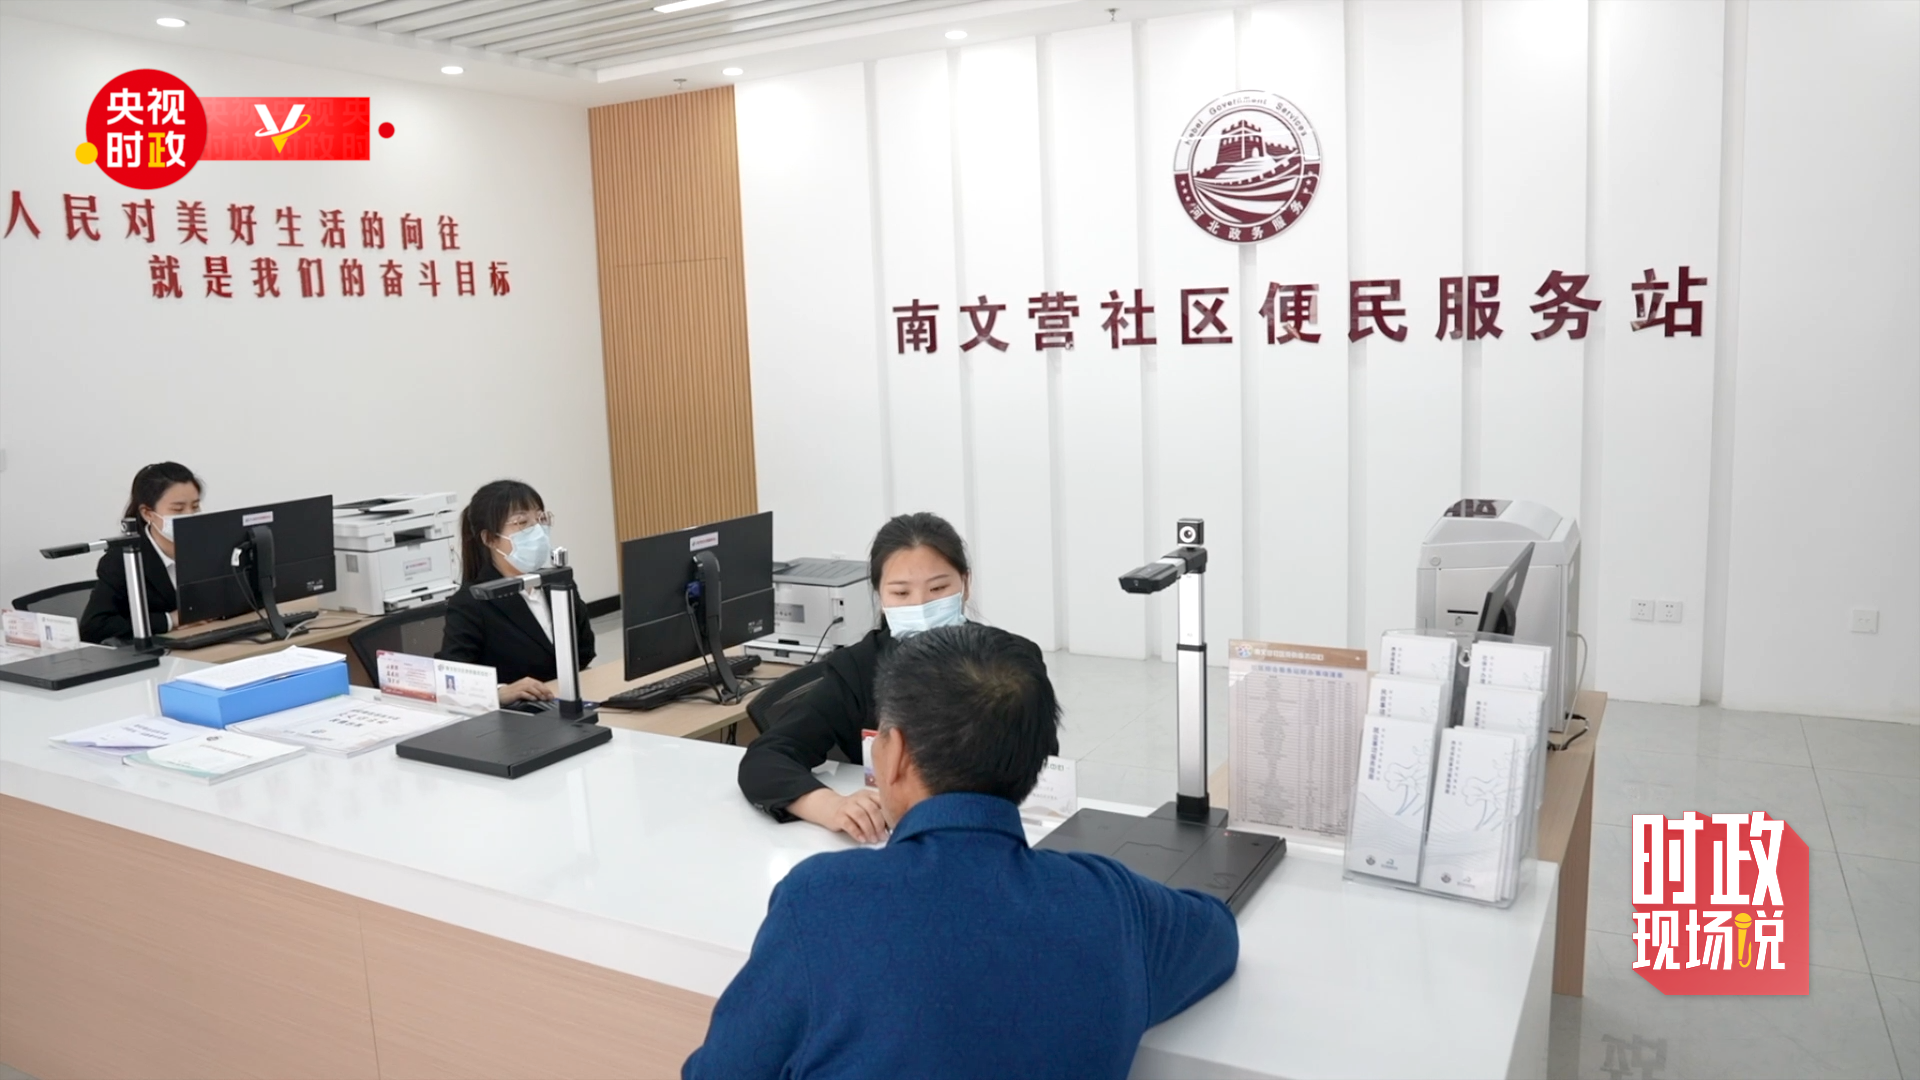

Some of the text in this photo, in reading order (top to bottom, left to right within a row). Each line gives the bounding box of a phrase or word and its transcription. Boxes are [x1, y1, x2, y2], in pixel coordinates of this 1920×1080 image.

[1275, 102, 1308, 137] Services
[4, 190, 461, 251] 人民对美好生活的向往
[1189, 202, 1304, 241] 河北政务服务
[148, 254, 511, 299] 就是我们的奋斗目标
[892, 265, 1709, 355] 南文营社区便民服务站
